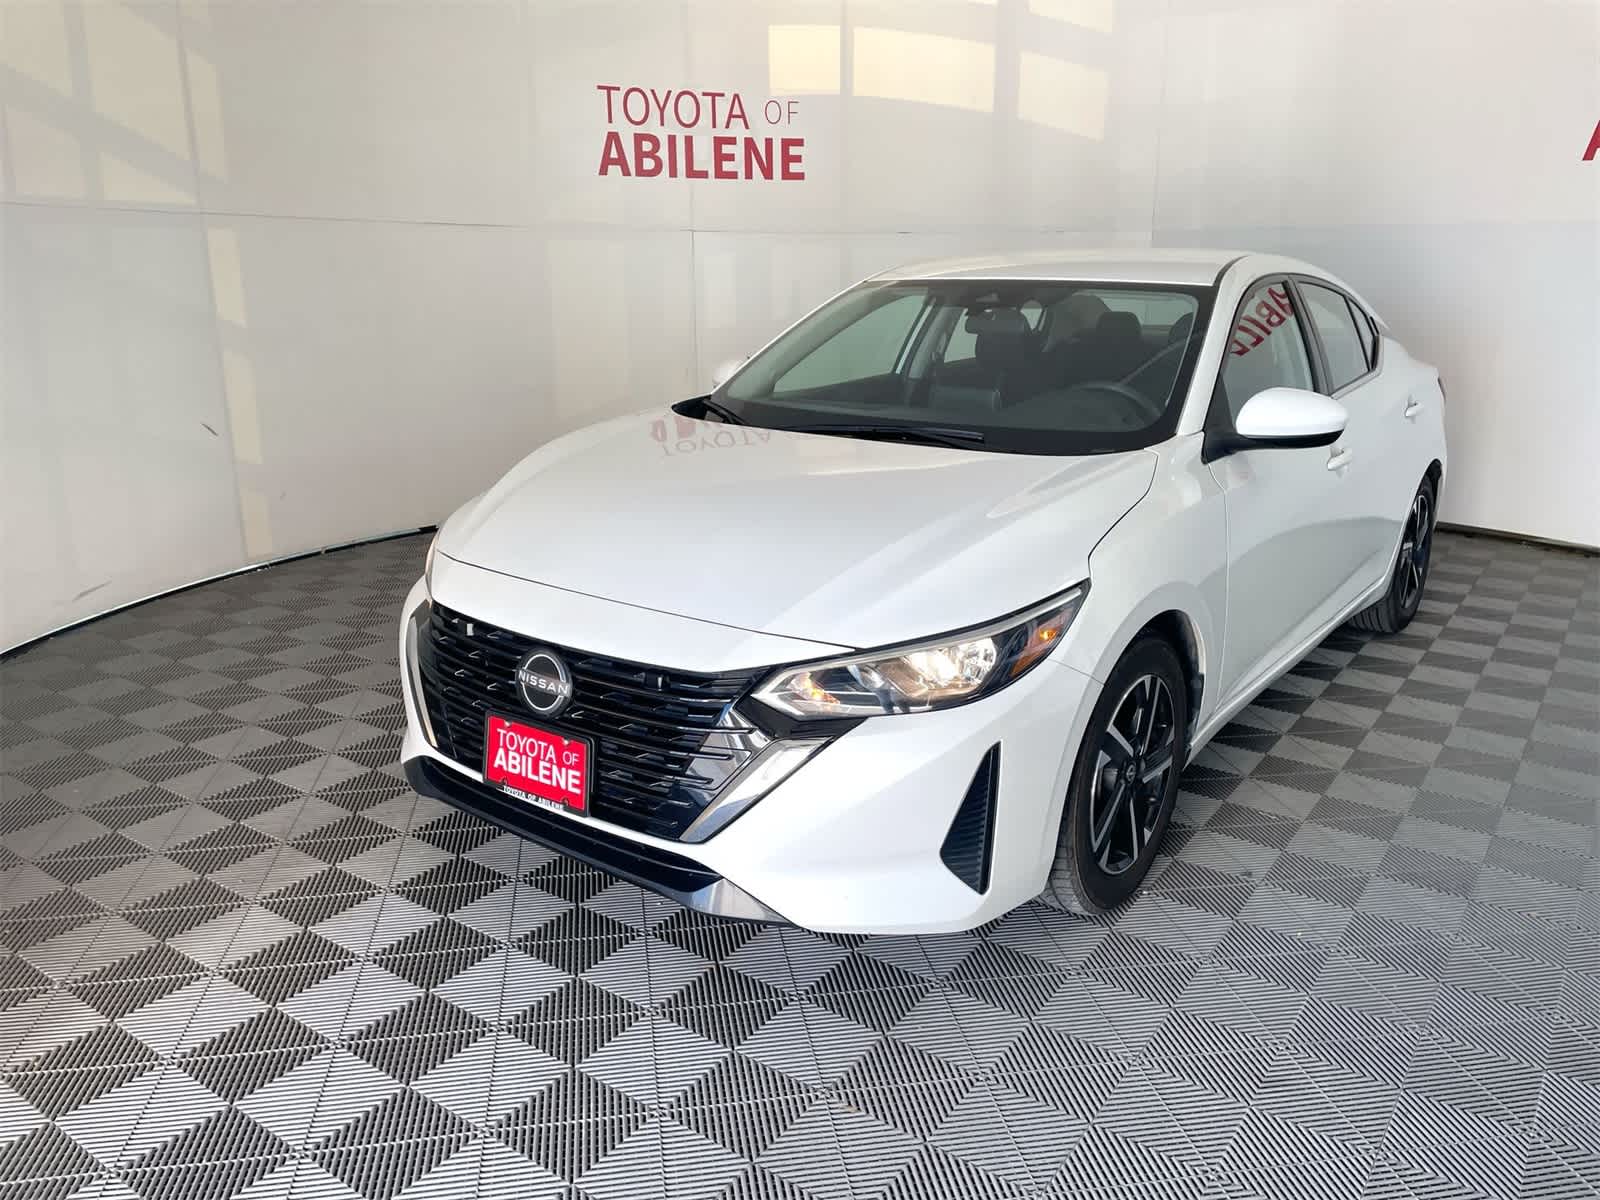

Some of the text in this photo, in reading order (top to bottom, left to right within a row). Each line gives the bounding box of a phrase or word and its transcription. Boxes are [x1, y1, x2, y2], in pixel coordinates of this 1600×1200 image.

[597, 84, 799, 129] TOYOTA OF
[598, 131, 806, 181] ABILENE
[518, 670, 570, 696] NISSAN
[497, 728, 579, 767] TOYOTA OF
[493, 748, 582, 794] ABILENE
